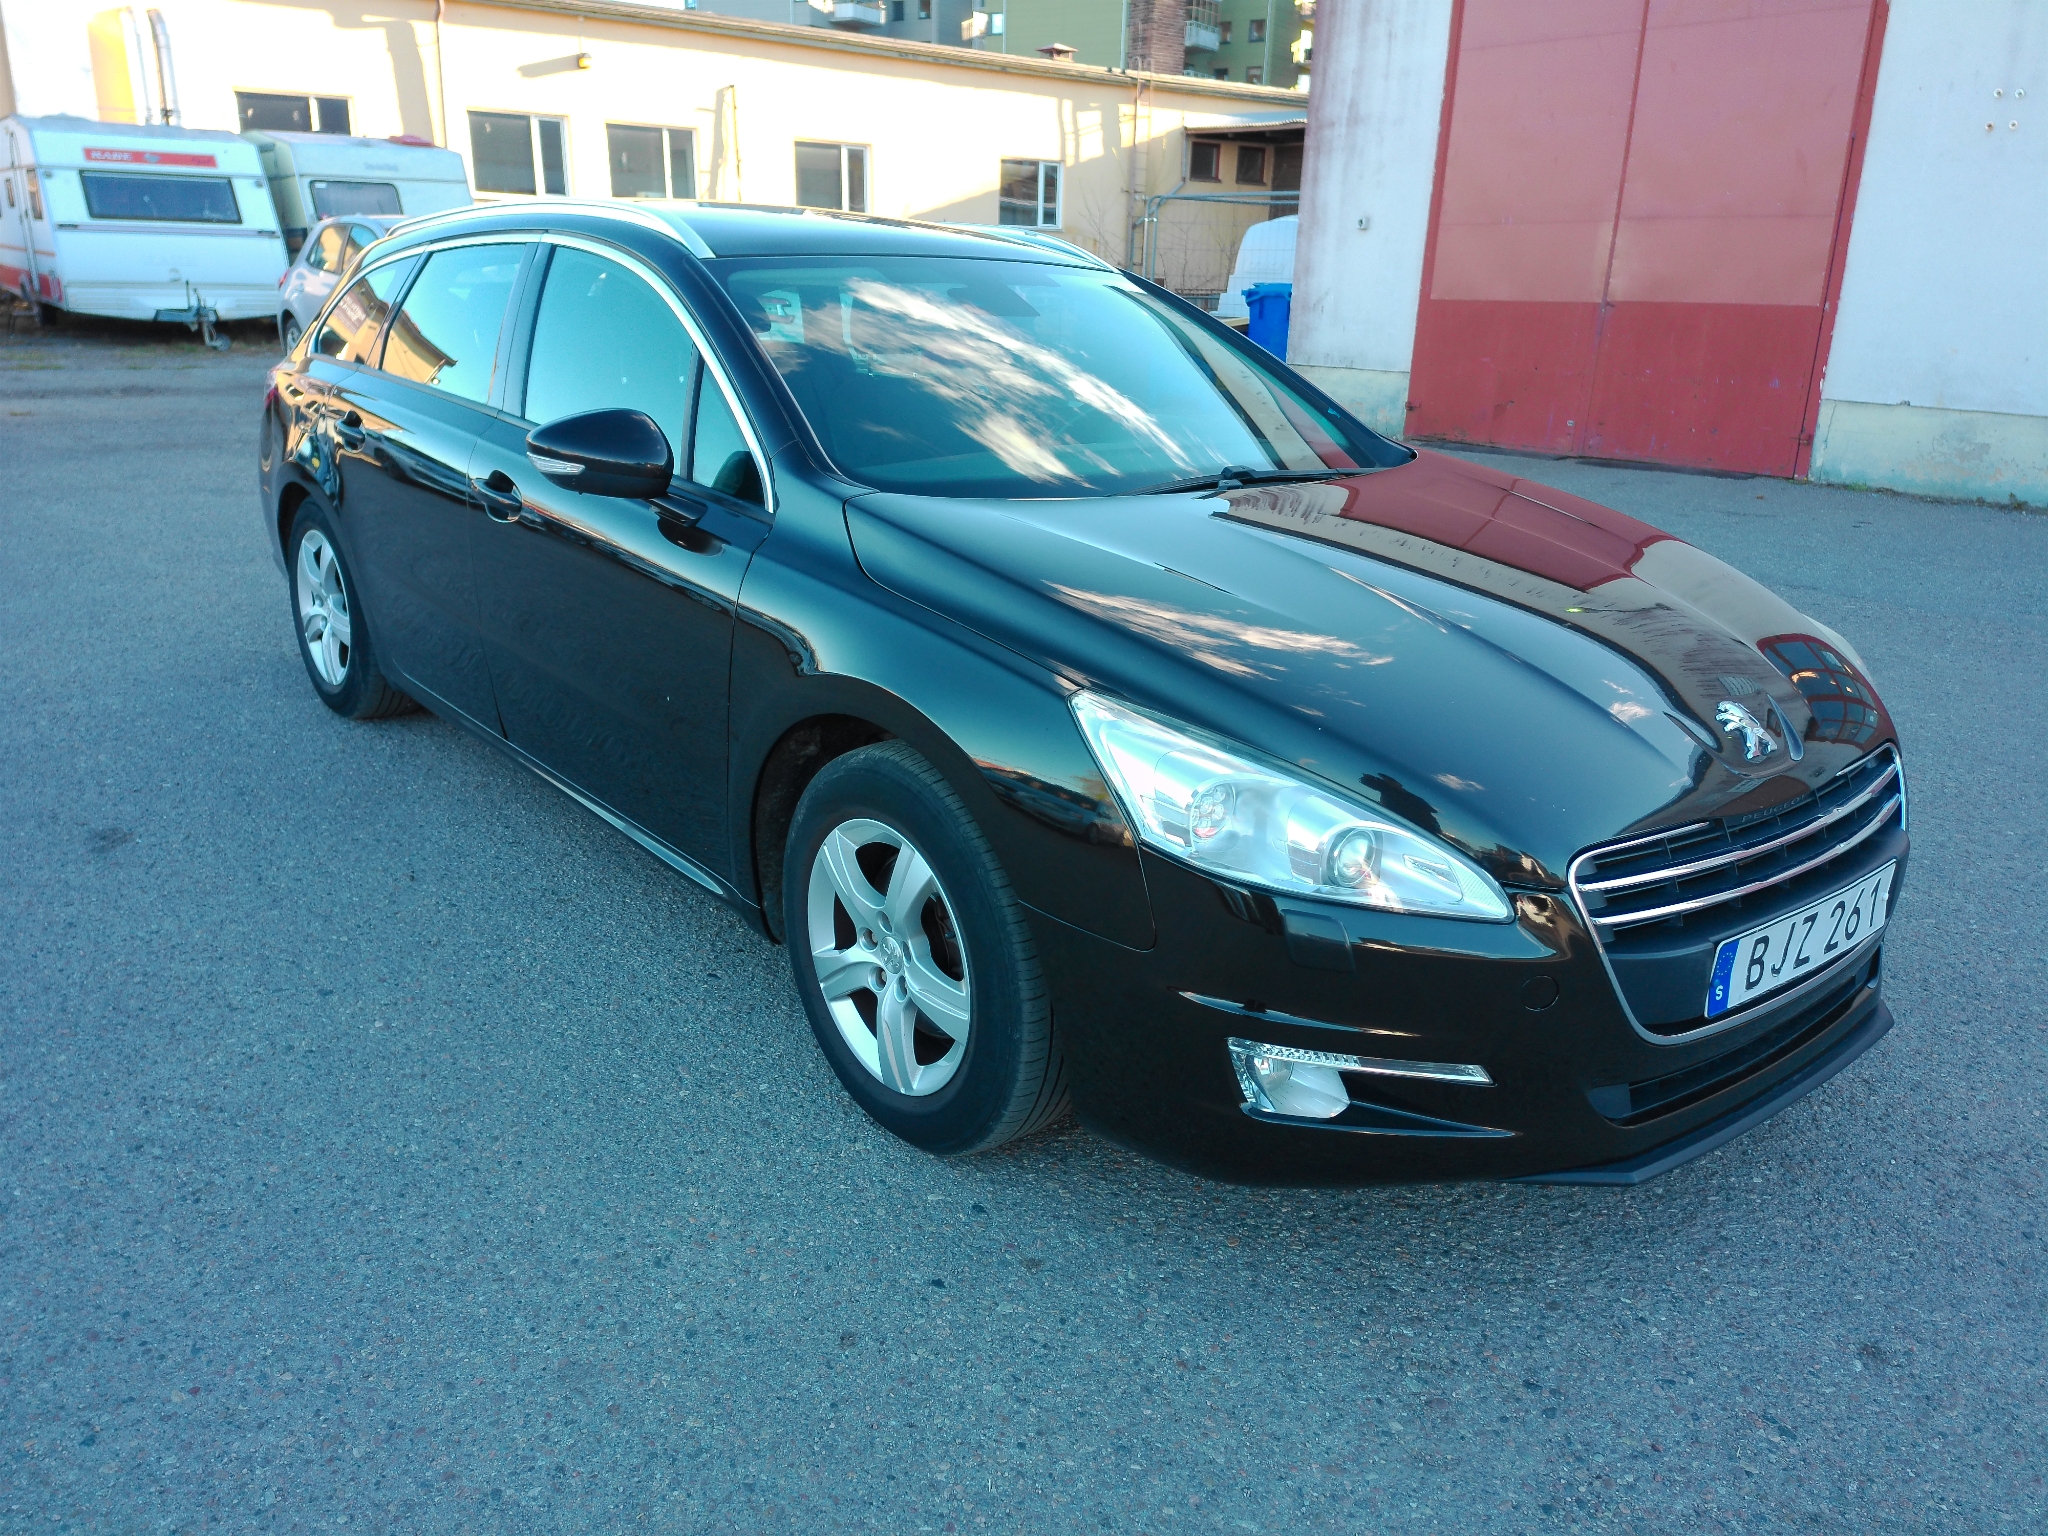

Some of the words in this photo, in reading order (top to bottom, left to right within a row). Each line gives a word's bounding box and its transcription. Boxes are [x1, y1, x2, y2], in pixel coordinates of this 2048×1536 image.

[1741, 794, 1805, 823] PEUGEOT
[1745, 911, 1818, 990] BJZ
[1824, 877, 1881, 955] 261
[1715, 985, 1723, 1000] S
